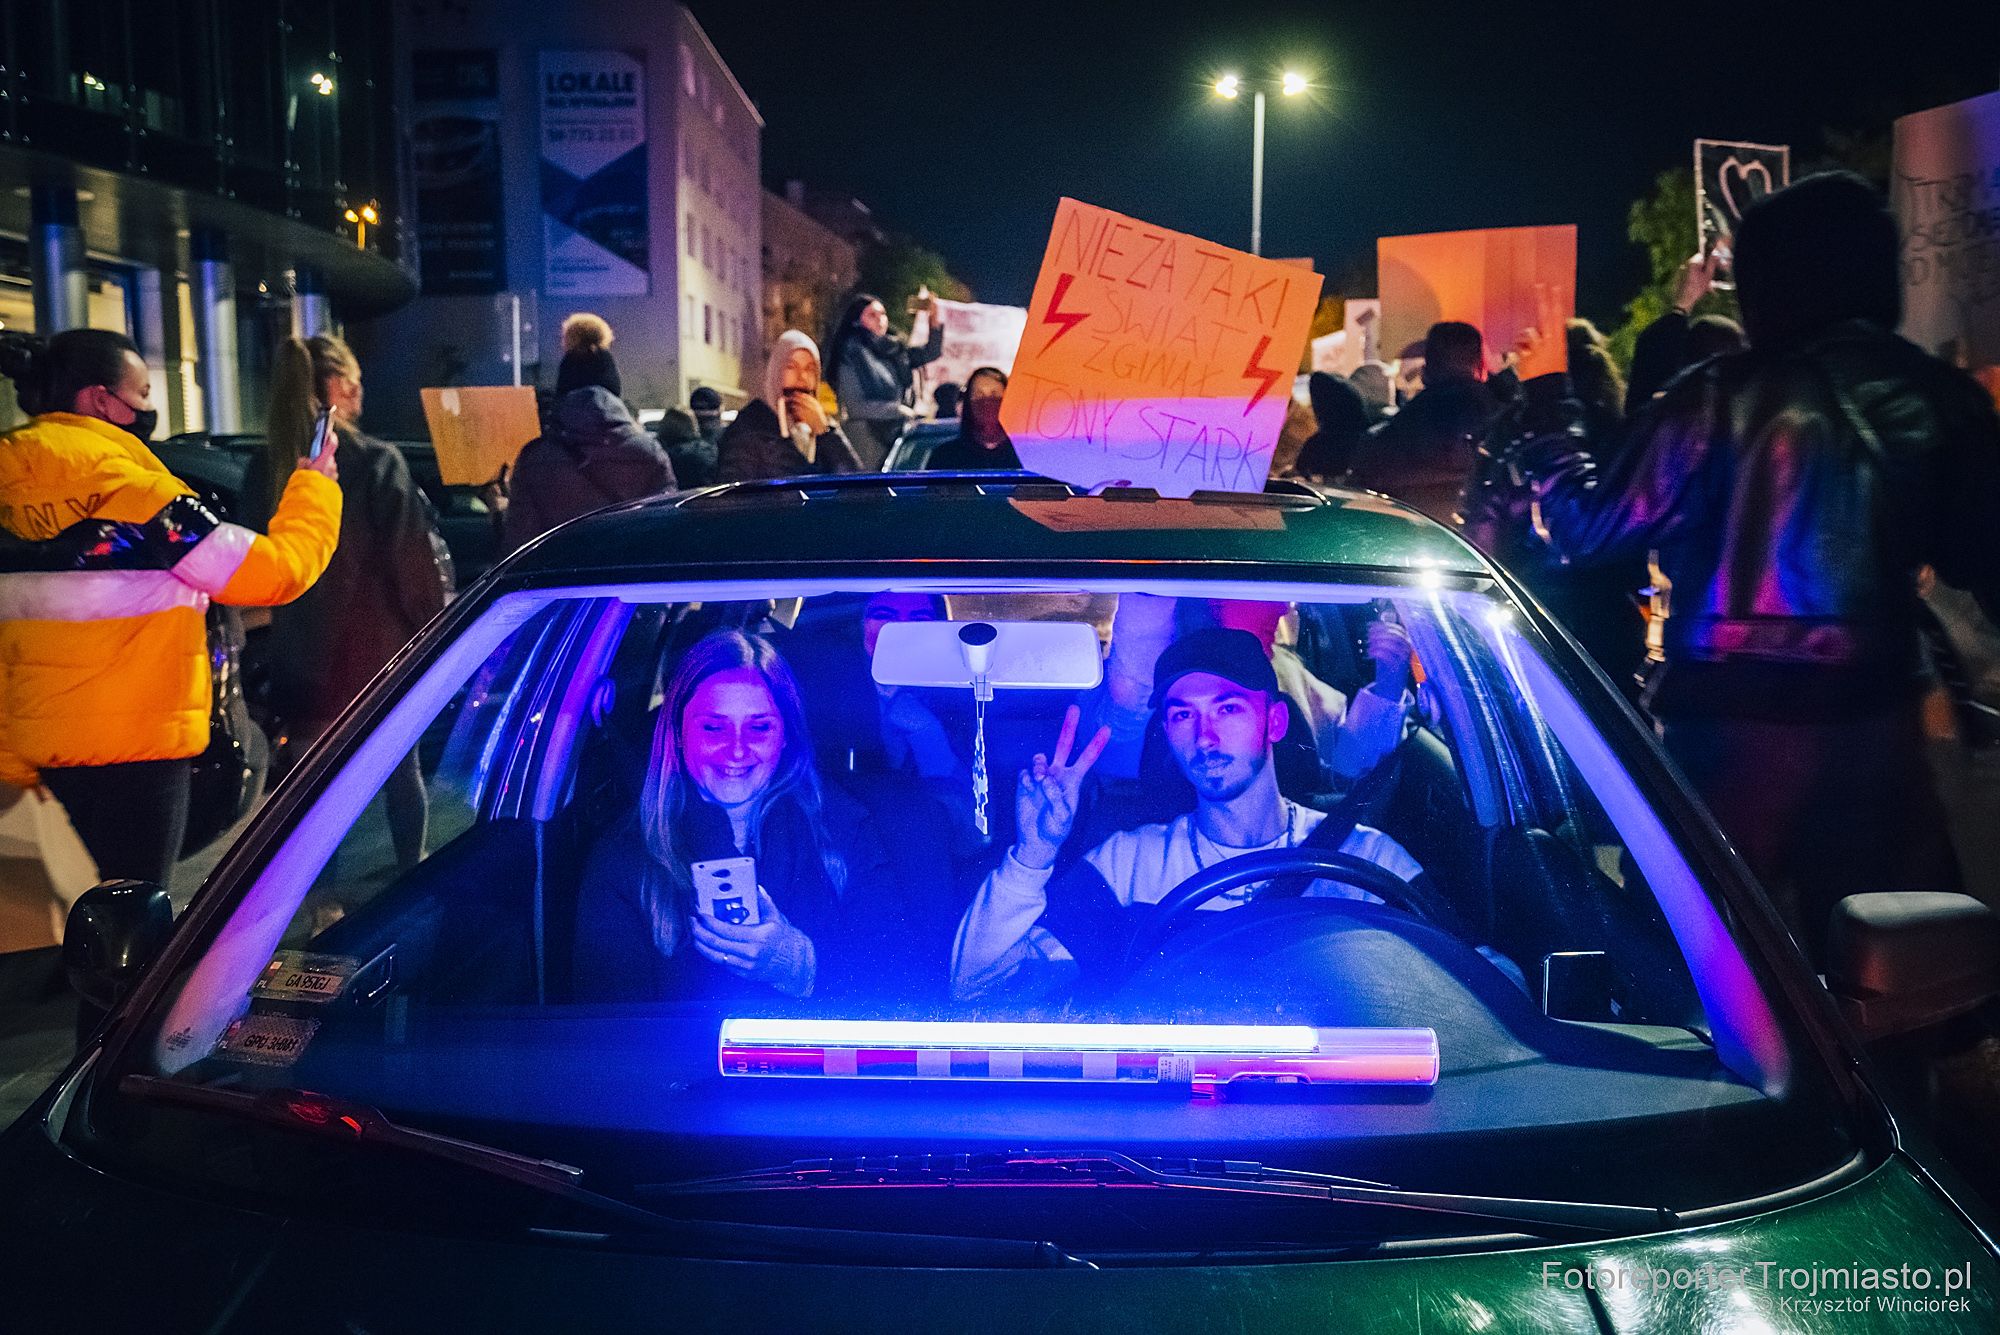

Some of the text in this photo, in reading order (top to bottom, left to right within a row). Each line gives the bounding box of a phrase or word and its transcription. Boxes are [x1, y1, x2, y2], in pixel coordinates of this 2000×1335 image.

[546, 72, 635, 93] LOKALE
[1020, 372, 1271, 492] TONY STARK
[285, 974, 302, 988] GA
